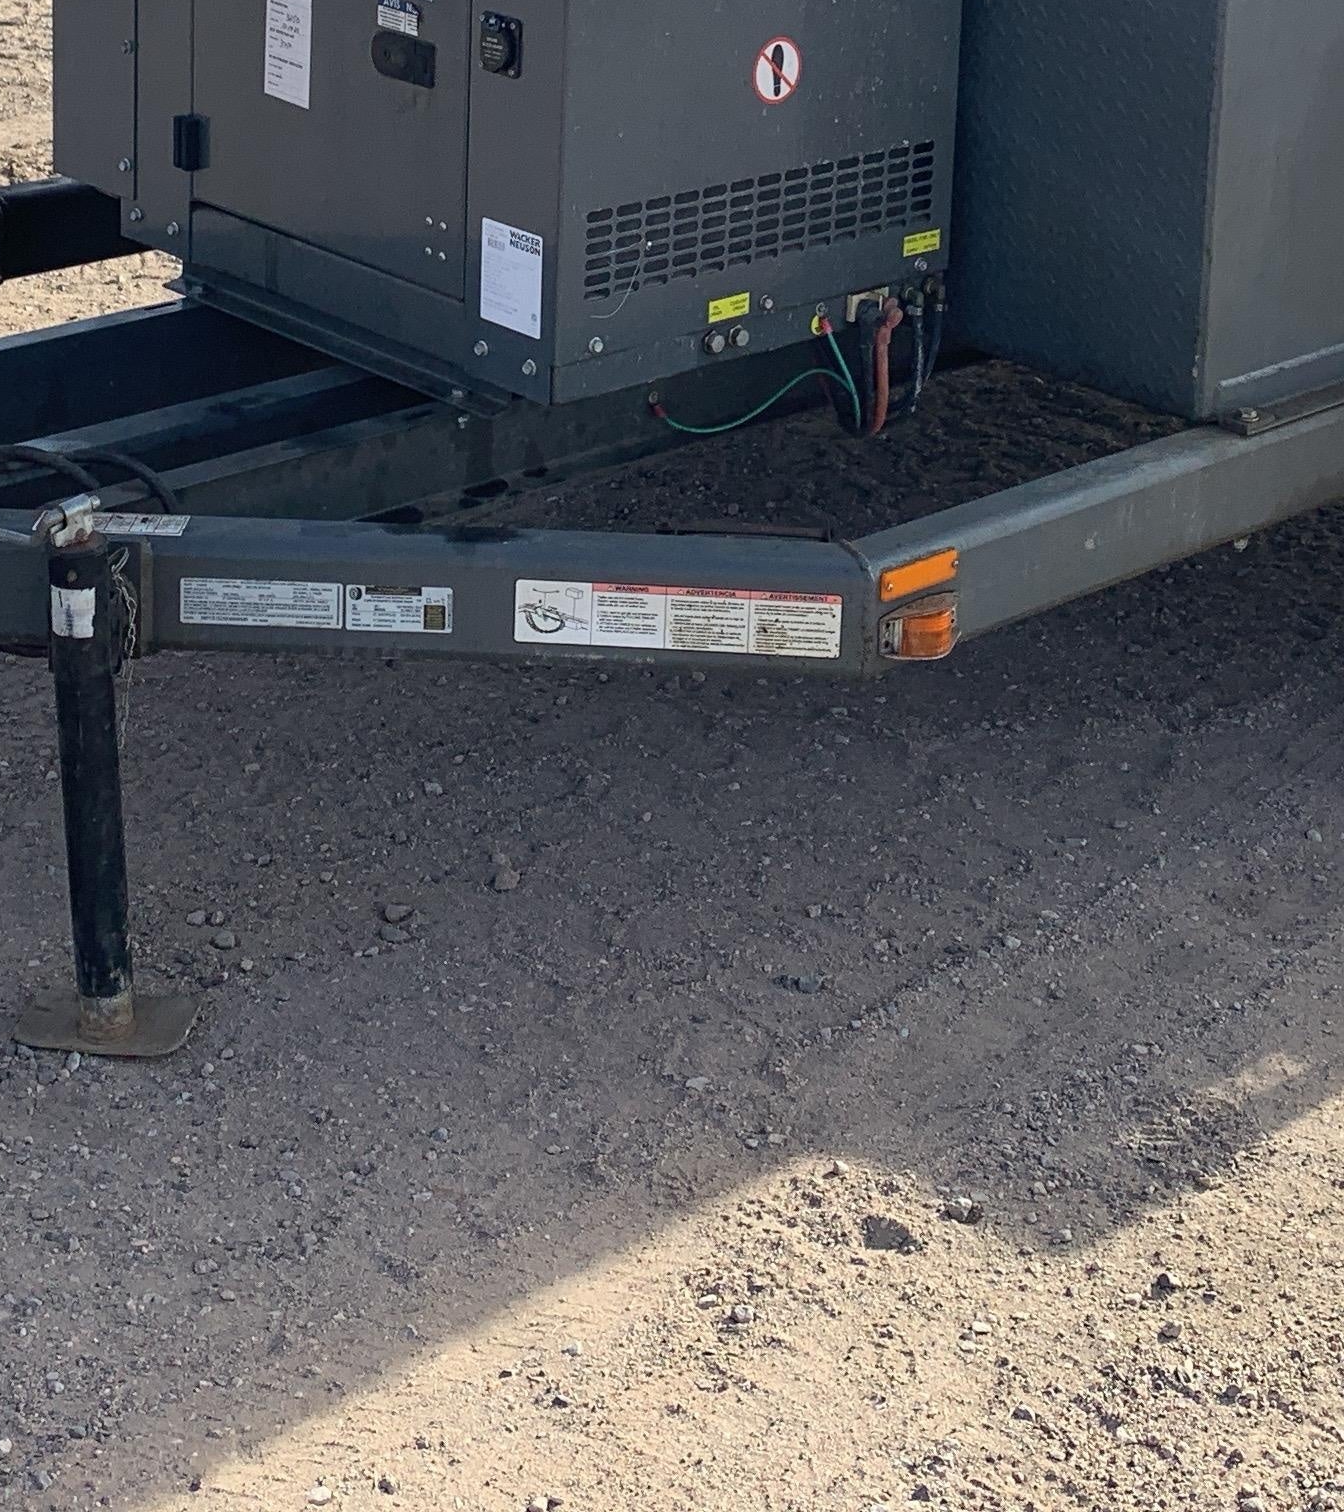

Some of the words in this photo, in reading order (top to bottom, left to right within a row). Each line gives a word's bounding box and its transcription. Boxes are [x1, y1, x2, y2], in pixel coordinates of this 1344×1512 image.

[510, 229, 541, 247] WACKER
[510, 238, 541, 257] NEUSON
[615, 585, 650, 594] WARNING
[685, 588, 737, 598] ADVERTENCIA
[768, 592, 829, 603] AVERTISSEMENT
